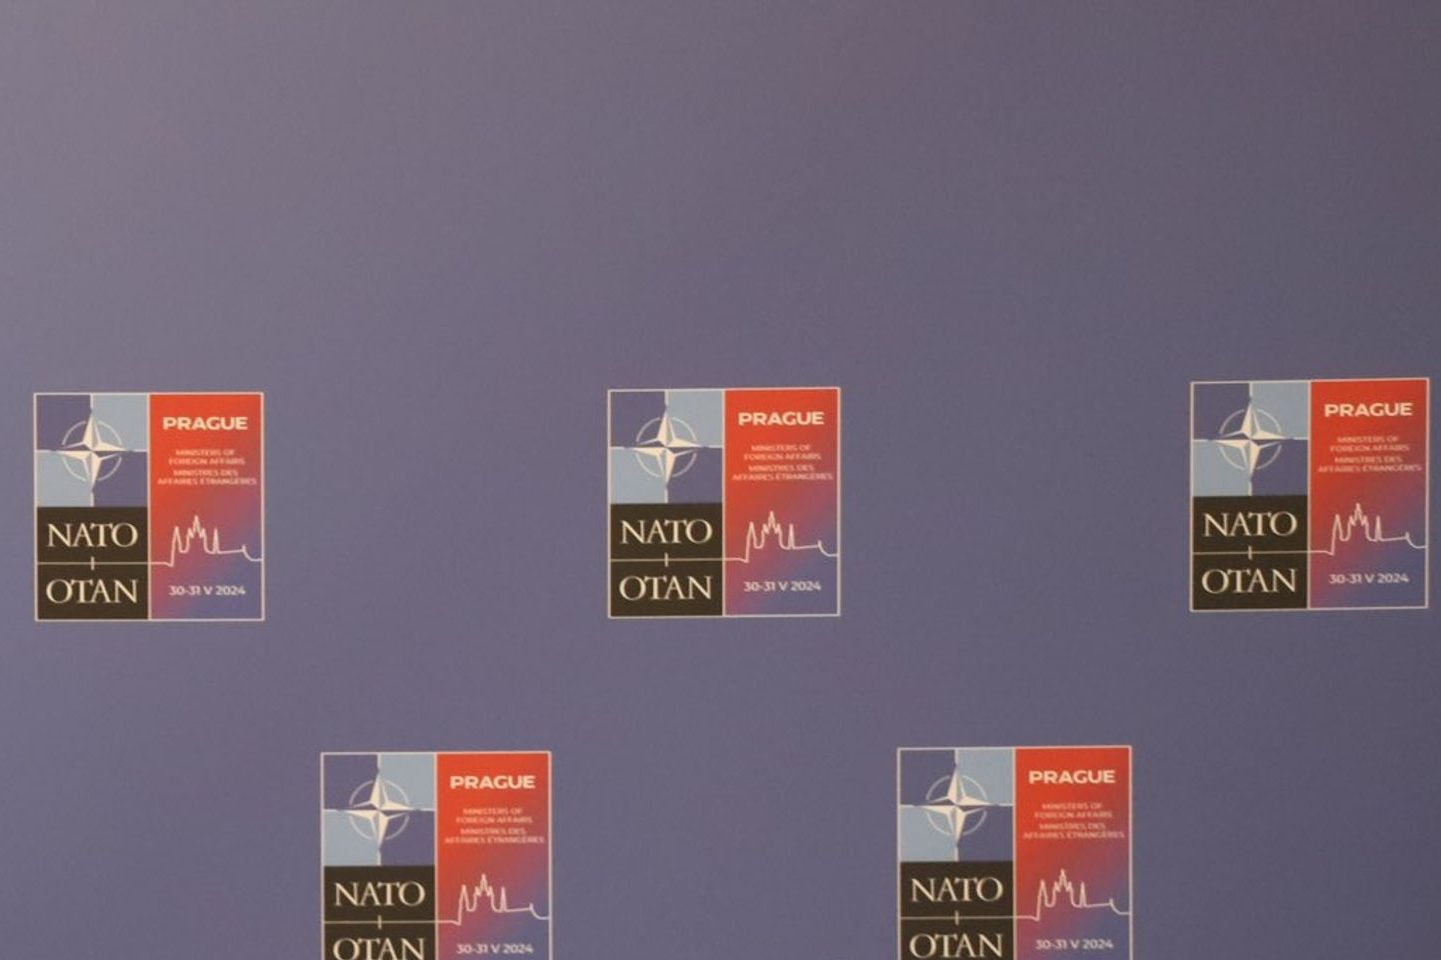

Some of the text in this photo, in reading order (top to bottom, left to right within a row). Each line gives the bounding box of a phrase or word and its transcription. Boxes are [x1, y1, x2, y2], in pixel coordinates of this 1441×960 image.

[1324, 402, 1413, 417] PRAGUE
[162, 416, 248, 430] PRAGUE
[738, 411, 824, 426] PRAGUE
[620, 518, 712, 544] NATO
[1203, 511, 1297, 537] NATO
[46, 522, 138, 547] NATO
[743, 581, 821, 591] 30-31 V 2024
[1201, 567, 1297, 594] OTAN
[1329, 573, 1409, 584] 30-31 V 2024
[45, 578, 138, 603] OTAN
[169, 585, 246, 595] 30-31 V 2024
[619, 574, 713, 600] OTAN
[450, 775, 535, 789] PRAGUE
[1028, 770, 1116, 784] PRAGUE
[334, 881, 425, 906] NATO
[910, 876, 1003, 902] NATO
[456, 943, 533, 954] 30-31 V 2024
[909, 932, 1004, 958] OTAN
[1035, 939, 1113, 949] 30-31 V 2024
